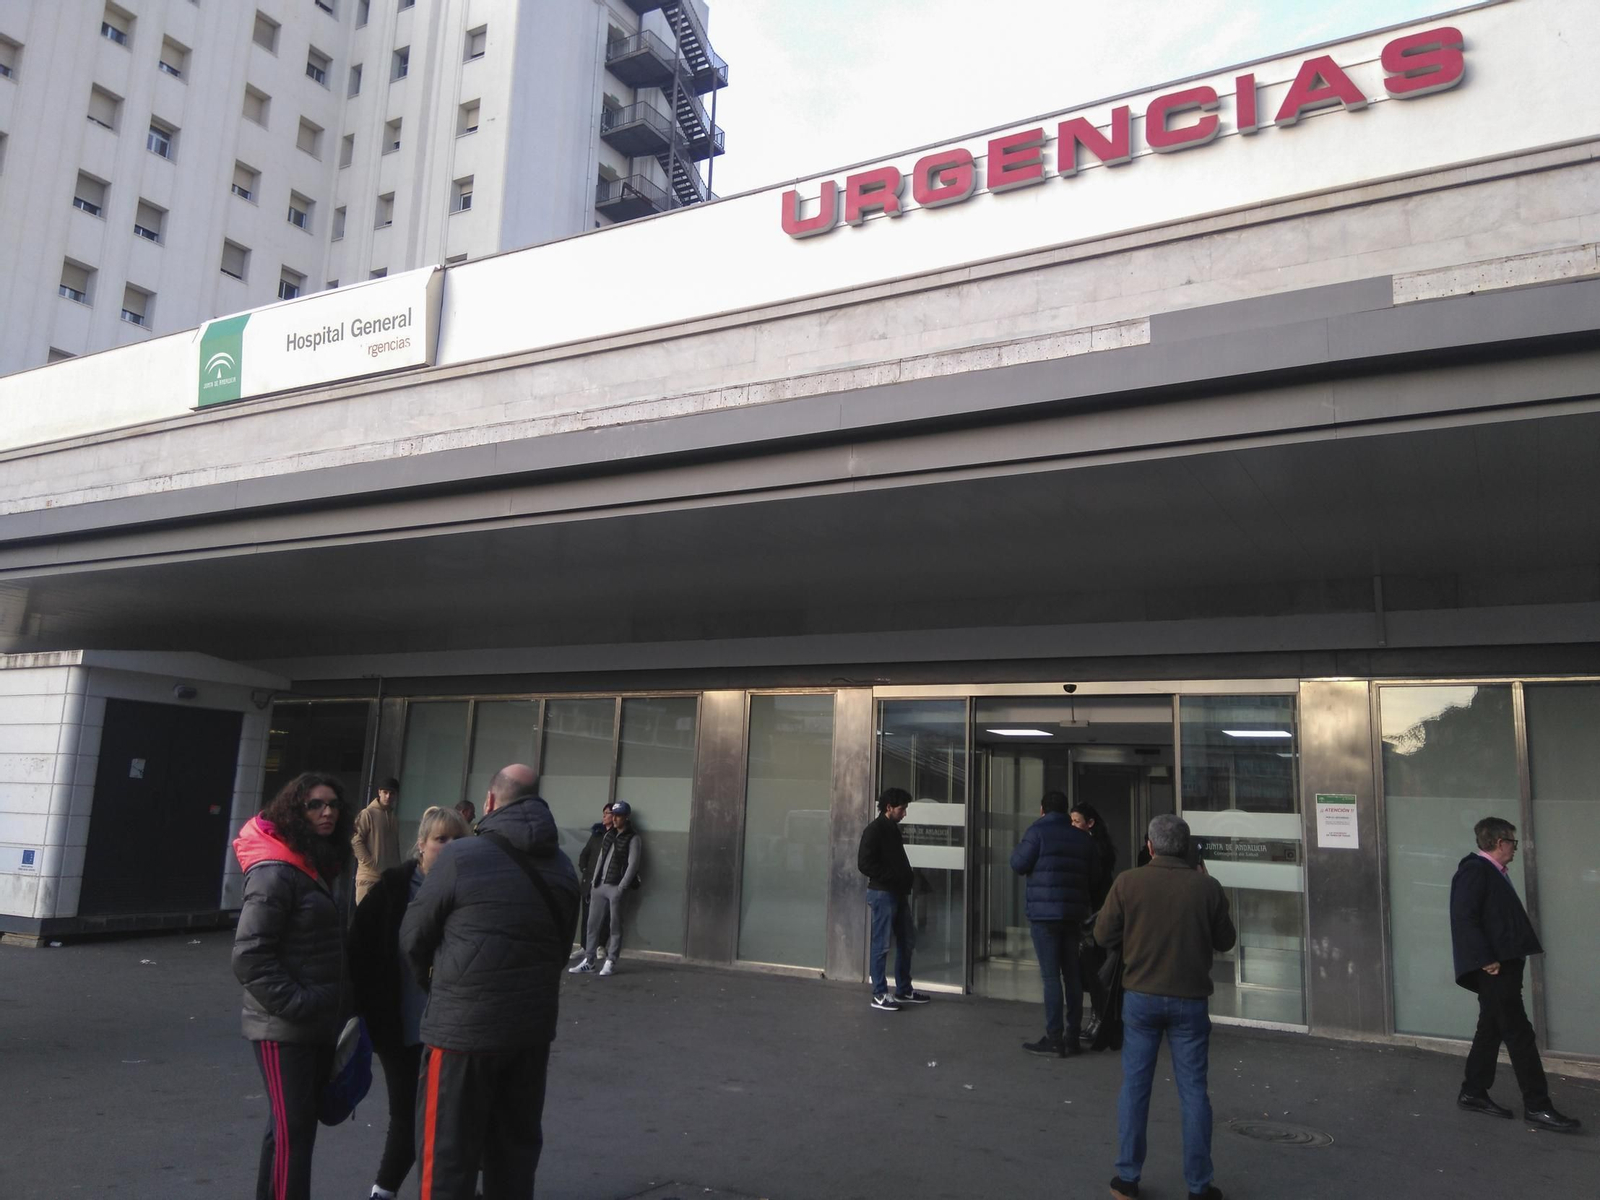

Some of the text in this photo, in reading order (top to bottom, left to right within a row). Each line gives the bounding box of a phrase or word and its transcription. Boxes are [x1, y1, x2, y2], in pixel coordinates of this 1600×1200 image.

[781, 26, 1464, 240] URGENCIAS
[286, 307, 412, 352] Hospital General
[1205, 843, 1224, 851] JUNTA
[1225, 843, 1233, 852] DE
